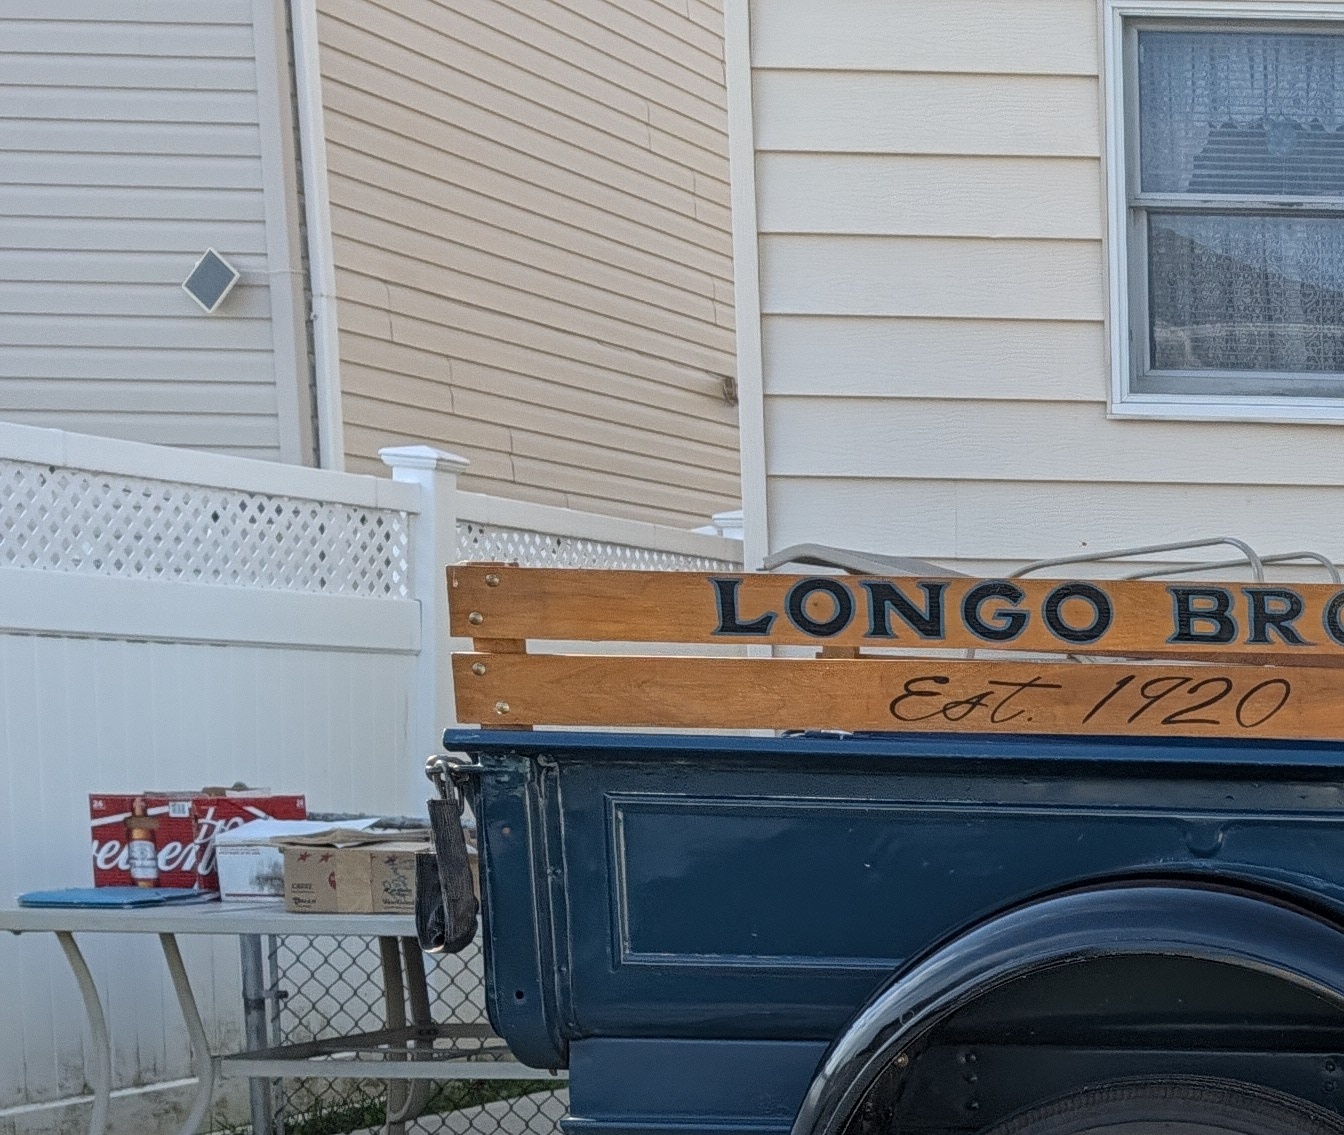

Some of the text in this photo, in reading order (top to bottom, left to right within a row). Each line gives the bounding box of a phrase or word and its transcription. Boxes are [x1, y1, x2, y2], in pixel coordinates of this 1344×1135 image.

[708, 576, 1114, 645] LONGO
[889, 674, 1291, 728] Est. 1920
